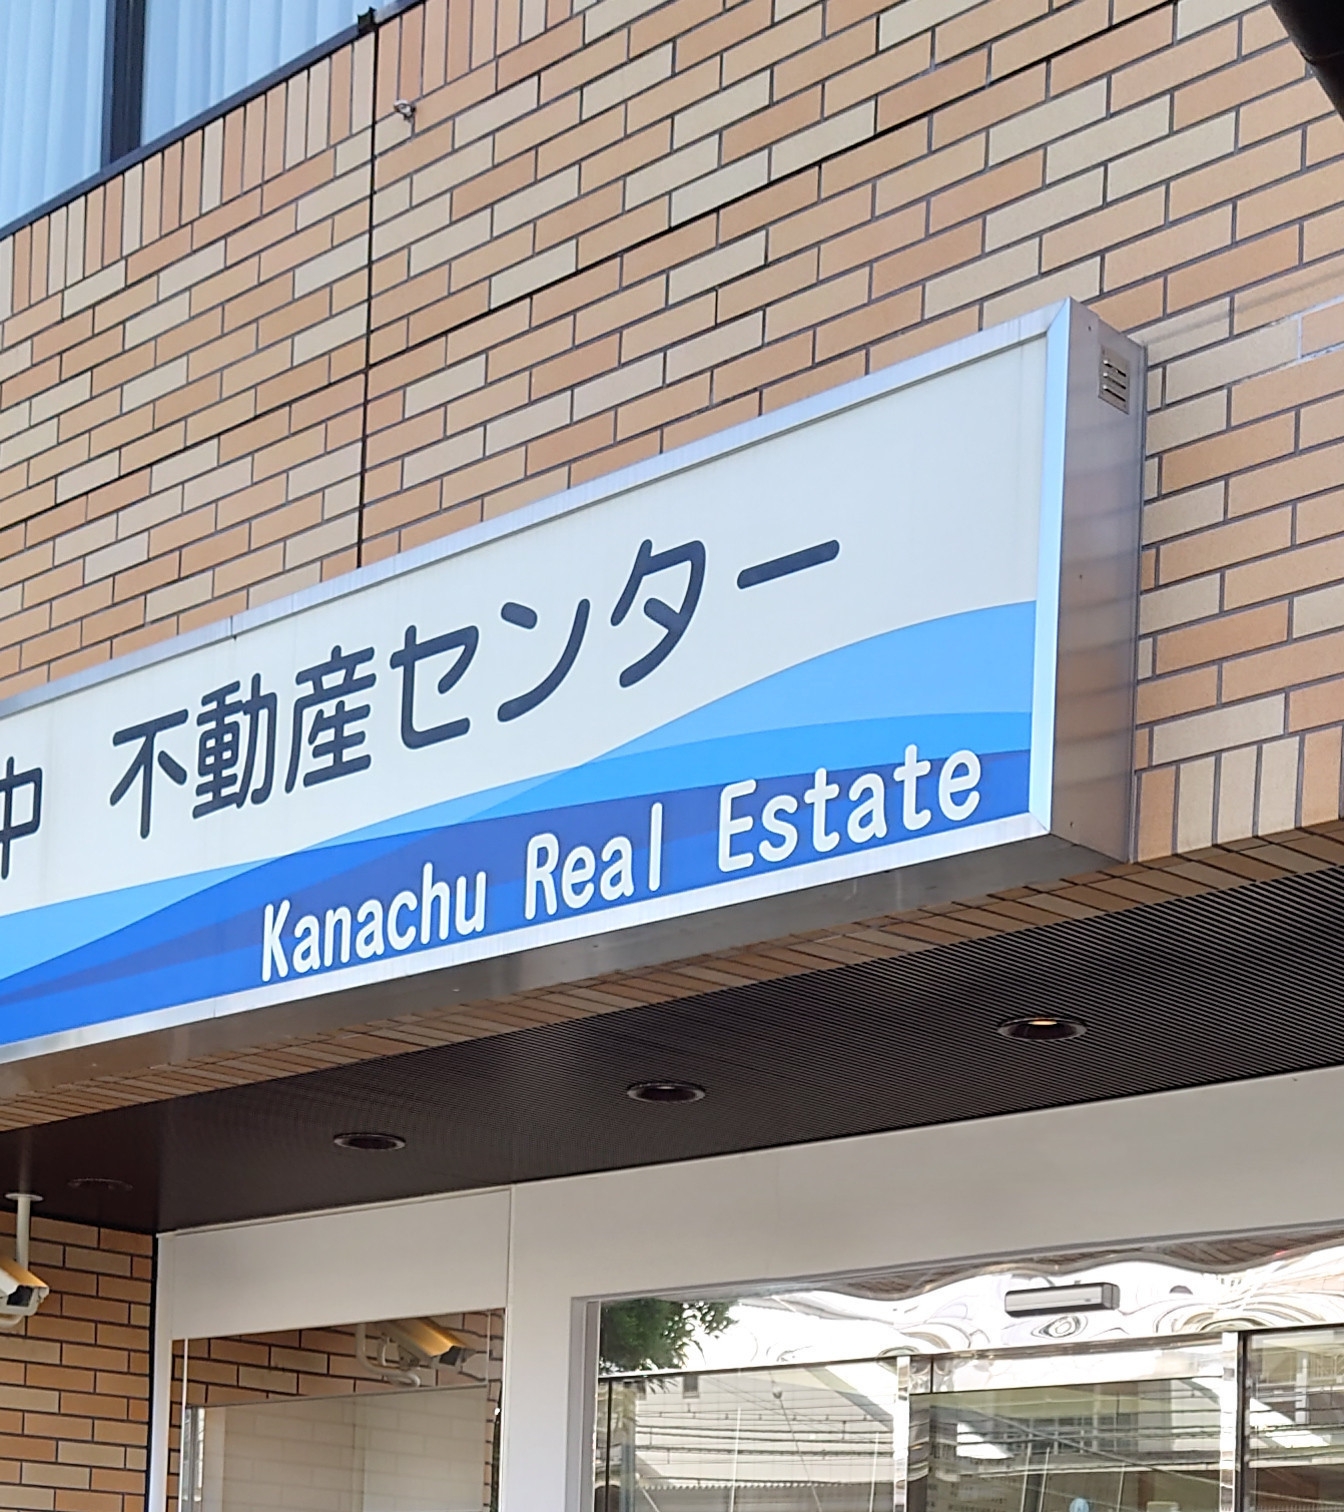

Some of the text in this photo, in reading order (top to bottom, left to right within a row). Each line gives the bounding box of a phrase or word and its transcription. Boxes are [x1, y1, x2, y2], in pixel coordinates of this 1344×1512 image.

[110, 537, 841, 839] 不動産センター
[259, 742, 982, 984] Kanachu Real Estate
